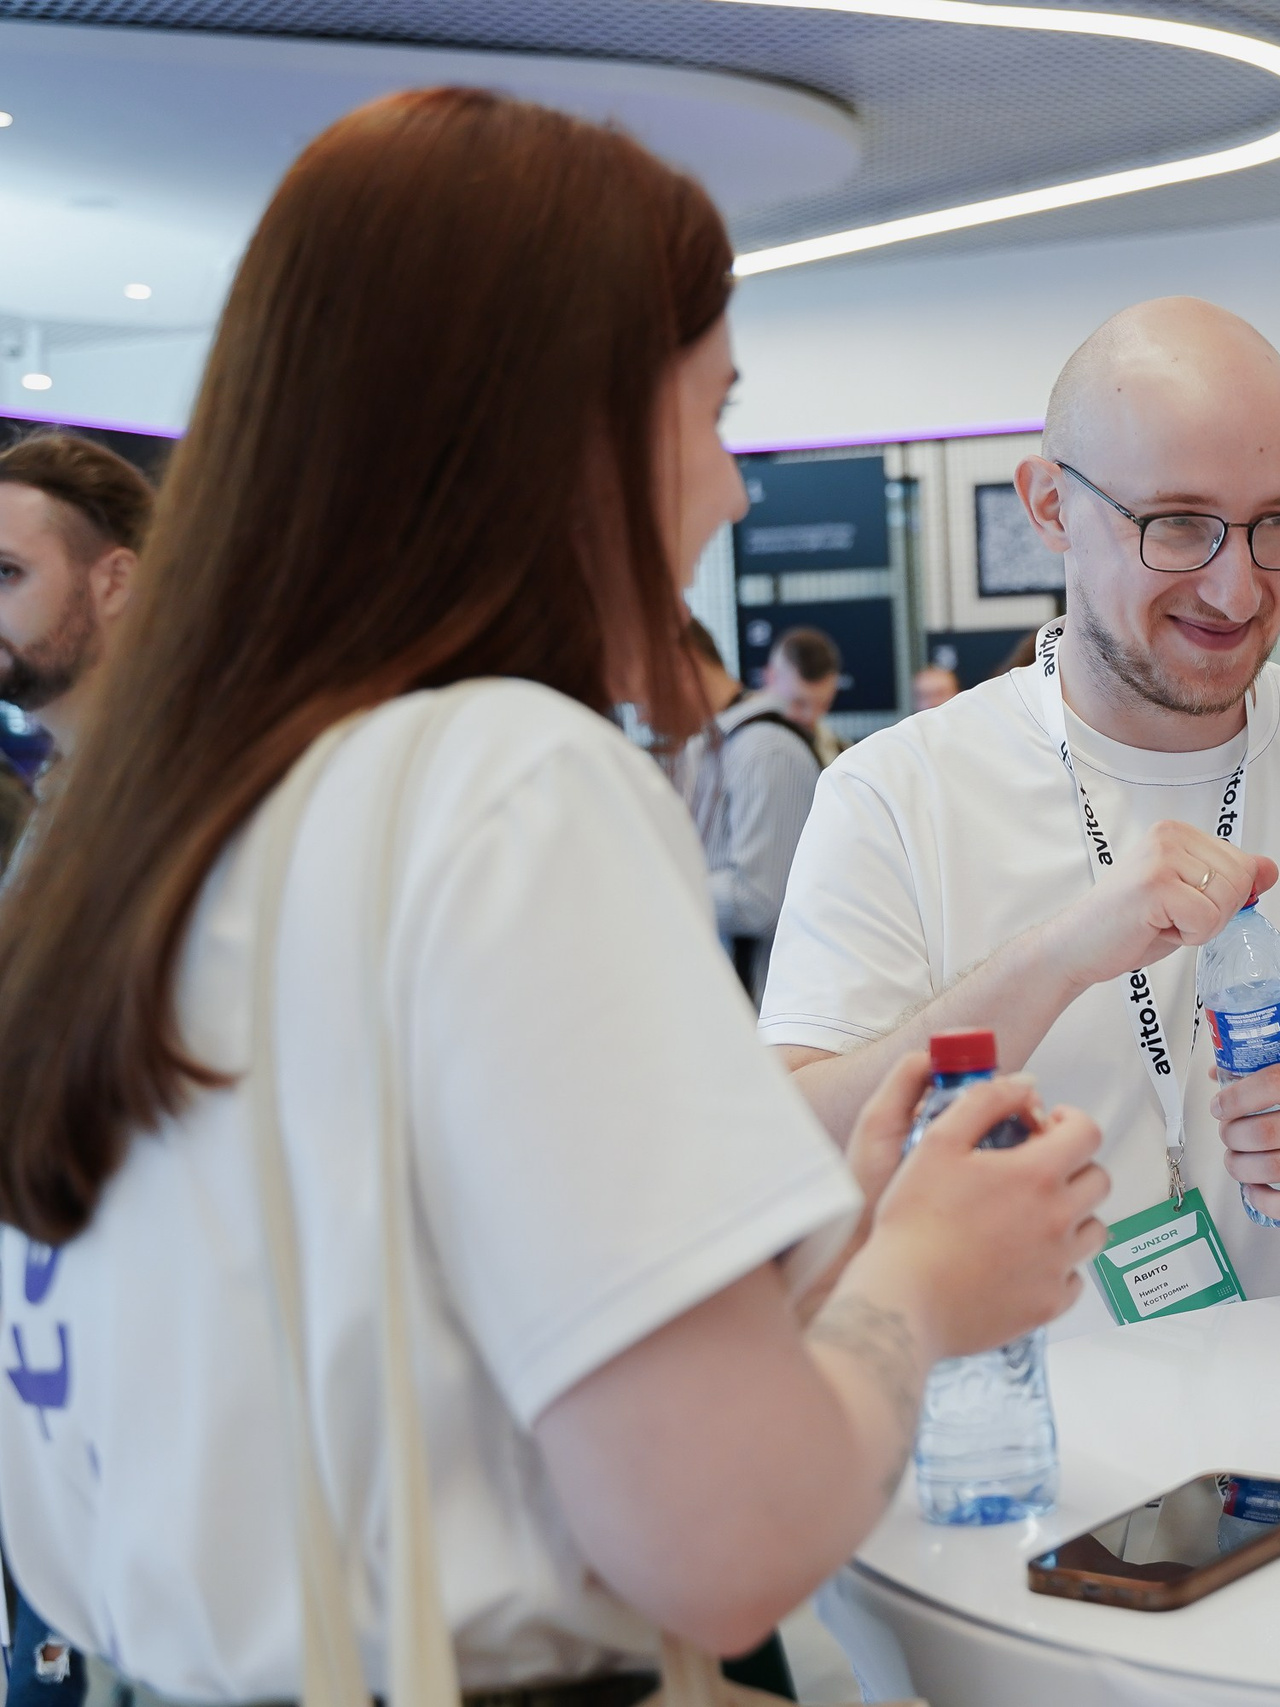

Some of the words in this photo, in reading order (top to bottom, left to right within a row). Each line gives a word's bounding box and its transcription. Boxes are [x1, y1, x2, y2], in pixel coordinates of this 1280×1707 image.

[1217, 766, 1244, 842] ito.te
[1130, 967, 1171, 1075] avito.te
[1131, 1229, 1178, 1254] JUNIOR
[1134, 1264, 1168, 1284] Авито
[1139, 1281, 1168, 1299] Никита
[1143, 1283, 1189, 1308] Костромин
